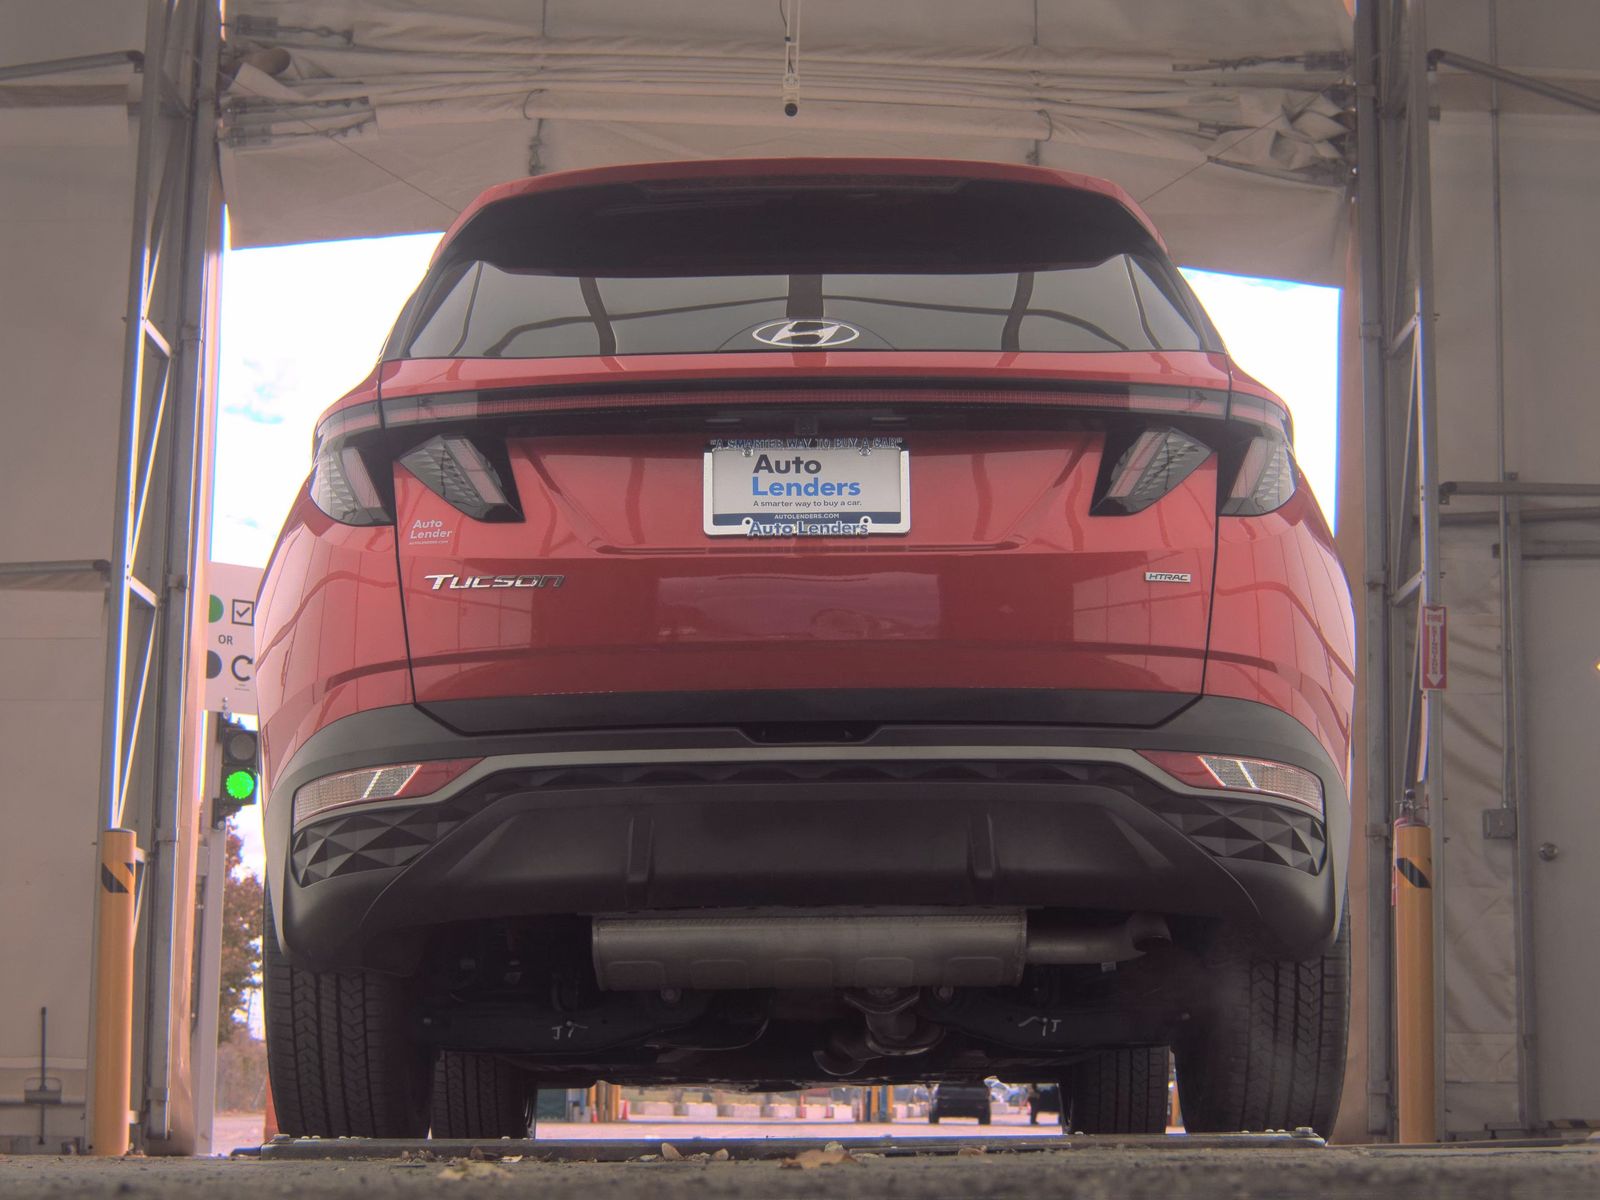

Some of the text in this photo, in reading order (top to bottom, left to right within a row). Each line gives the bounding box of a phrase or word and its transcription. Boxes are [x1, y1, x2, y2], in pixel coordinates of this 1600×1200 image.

[786, 438, 812, 449] WAY
[815, 438, 831, 449] TO
[834, 437, 858, 449] BUY
[861, 437, 870, 449] A
[752, 454, 822, 474] Auto
[752, 476, 861, 497] Lenders
[823, 500, 839, 508] buy
[413, 519, 443, 529] Auto
[747, 521, 869, 536] Auto Lenders
[1148, 573, 1188, 581] HTRAC
[218, 634, 233, 645] OR
